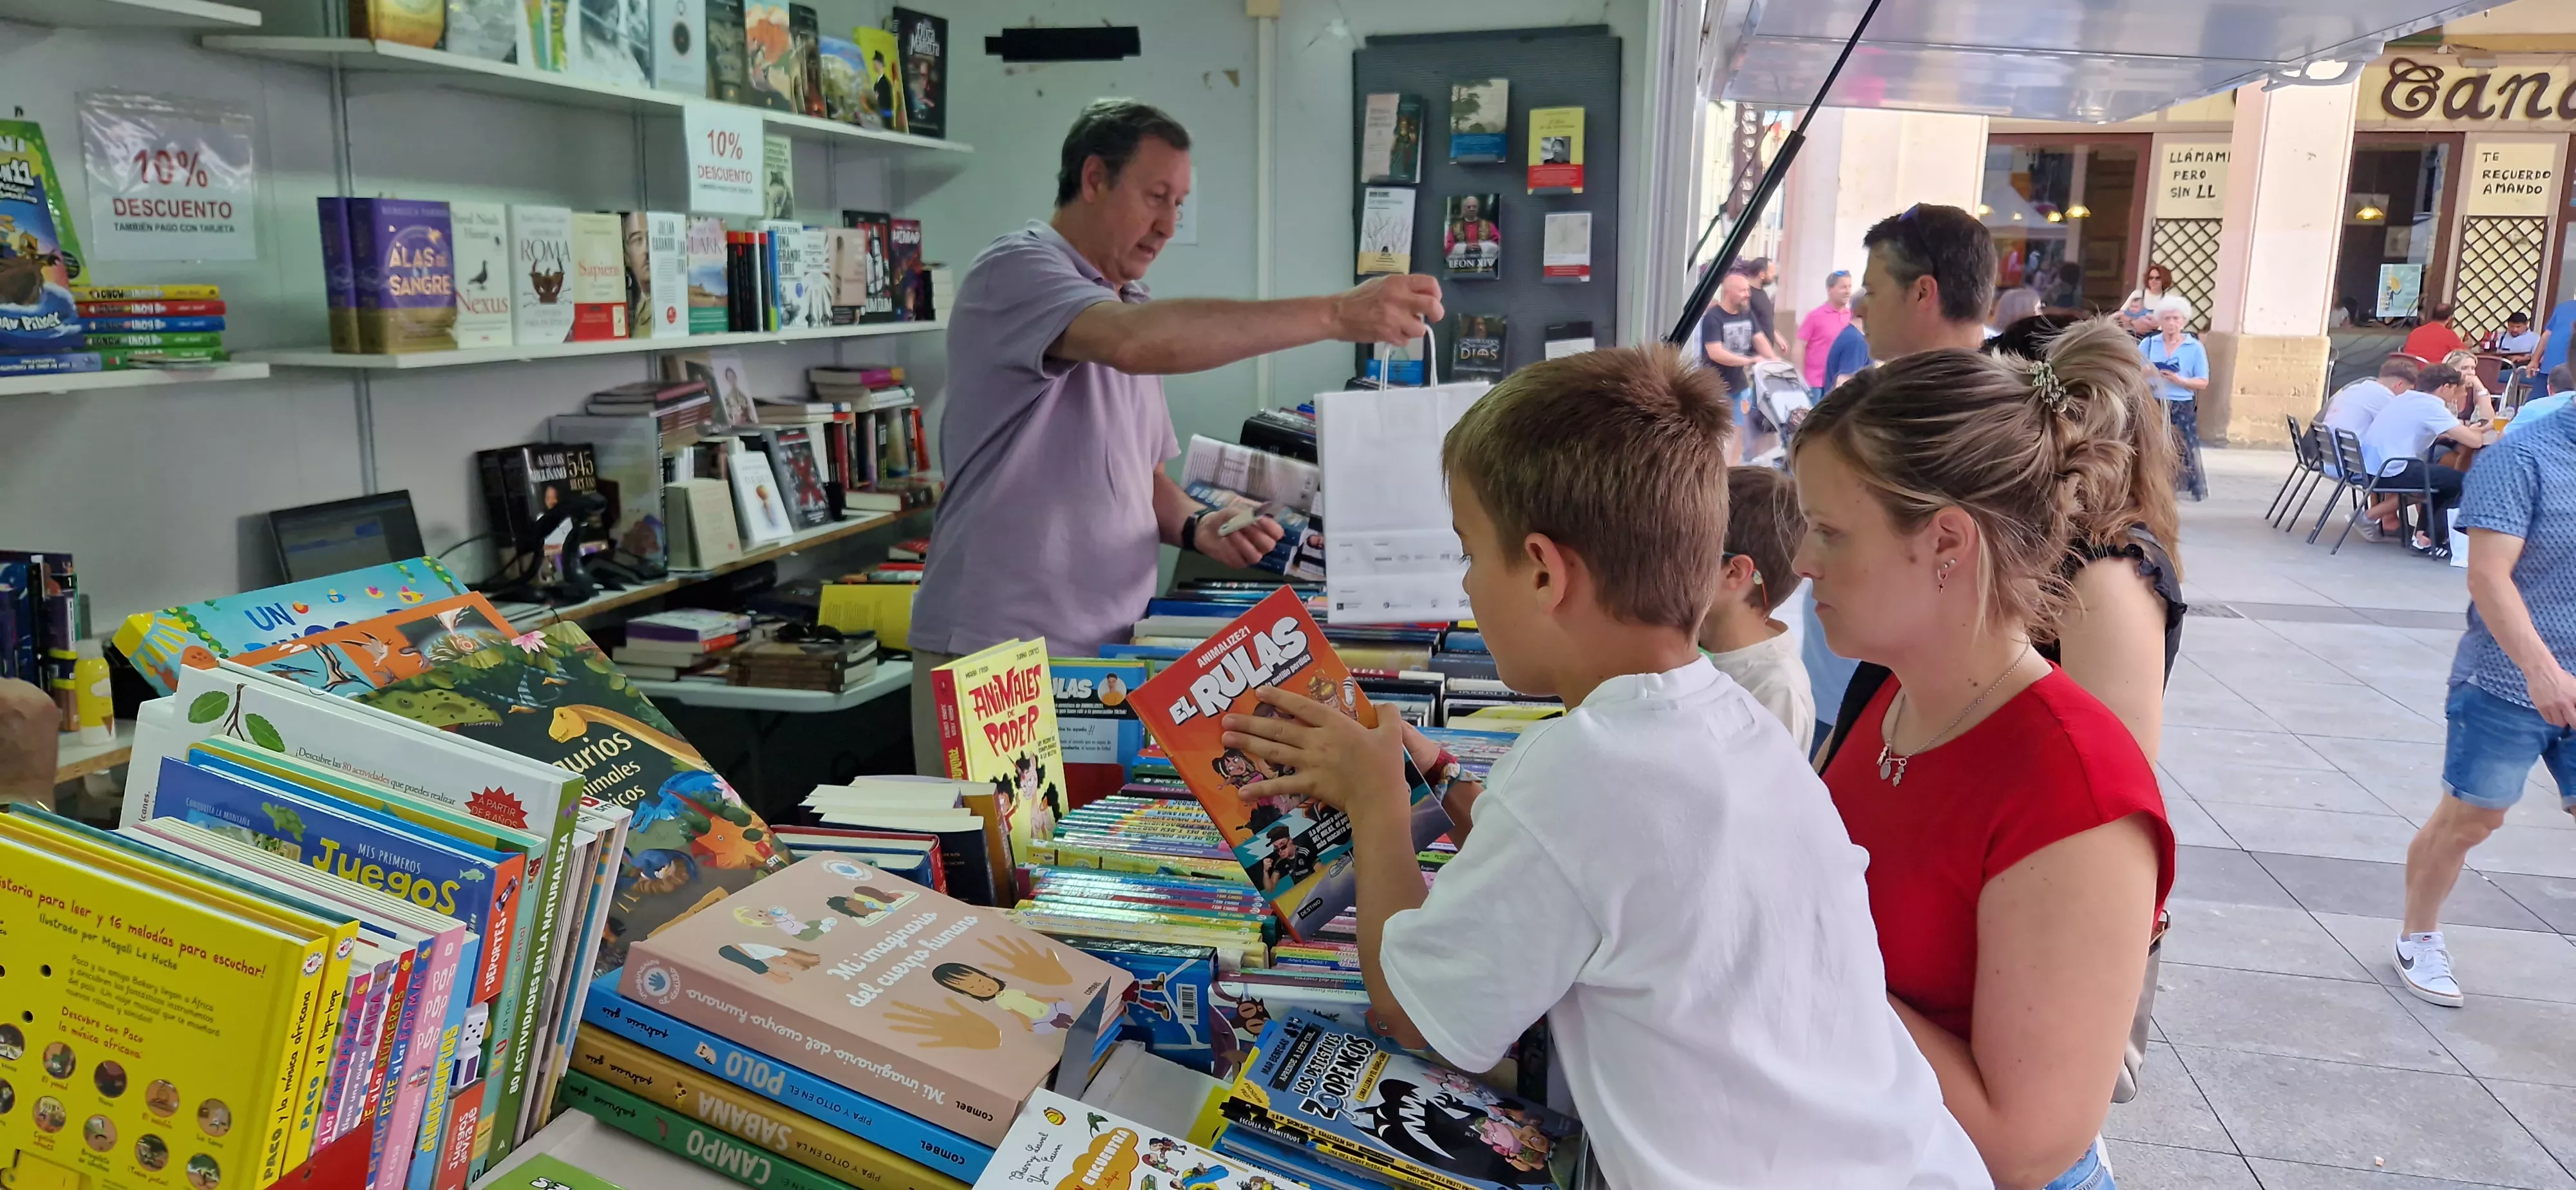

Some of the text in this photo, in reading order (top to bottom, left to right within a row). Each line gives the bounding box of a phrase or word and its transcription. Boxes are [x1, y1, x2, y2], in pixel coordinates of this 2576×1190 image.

[707, 129, 743, 160] 10%
[2483, 152, 2499, 162] TE
[134, 149, 208, 188] 10%
[697, 165, 752, 184] DESCUENTO
[2173, 169, 2206, 180] PERO
[2482, 170, 2552, 181] RECUERDO
[113, 198, 232, 219] DESCUENTO
[2170, 184, 2216, 199] SIN LL
[155, 223, 177, 232] PAGO
[180, 223, 198, 232] CON
[200, 223, 234, 233] TARJETA
[389, 247, 434, 268] ALAS
[520, 239, 571, 262] ROMA
[1477, 258, 1496, 268] XIV
[389, 274, 452, 297] SANGRE
[456, 290, 509, 314] Nexus
[566, 451, 594, 477] 545
[244, 601, 297, 632] UN
[1197, 625, 1252, 668] ANIMALIZE21
[1289, 653, 1312, 674] perdida
[1170, 616, 1308, 725] EL RULAS
[983, 704, 1041, 757] PODER
[1007, 708, 1016, 719] DE
[331, 757, 342, 770] las
[342, 760, 352, 771] 80
[351, 762, 390, 788] actividades
[390, 779, 405, 791] que
[404, 780, 430, 797] puedes
[430, 787, 456, 806] realizar
[471, 805, 483, 817] DE
[487, 798, 516, 818] PARTIR
[358, 843, 421, 874] MIS PRIMEROS
[765, 853, 781, 867] sm
[312, 838, 462, 915] Juegos
[1300, 899, 1321, 918] DESTINO
[38, 894, 65, 909] para
[71, 900, 91, 918] leer
[96, 914, 104, 929] y
[109, 915, 122, 929] 16
[128, 927, 174, 948] melodías
[179, 942, 207, 959] para
[213, 953, 267, 979] escuchar!
[82, 931, 97, 943] por
[486, 920, 507, 985] DEPORTES
[515, 925, 526, 963] pañal
[827, 911, 938, 981] Mi imaginario
[432, 963, 457, 994] POP
[509, 832, 570, 1095] 80 ACTIVIDADES EN LA NATURALEZA
[847, 915, 979, 1008] del cuerpo humano
[398, 969, 426, 1041] FORMAS
[424, 995, 448, 1026] POP
[502, 999, 512, 1015] no
[377, 989, 406, 1069] NÚMEROS
[417, 1025, 440, 1057] POP
[502, 1018, 511, 1035] ya
[299, 988, 342, 1131] PACO el hip-hop
[341, 990, 384, 1131] tiene una nueva AMIGA
[396, 1042, 406, 1062] las
[489, 1038, 508, 1081] IKU
[625, 1017, 787, 1096] POLO patricia
[686, 988, 946, 1106] Mi imaginario del cuerpo humano
[1260, 1037, 1291, 1076] MAR BENEGAS
[263, 990, 312, 1182] PACO la música africana
[379, 1075, 399, 1116] PEPE
[419, 1024, 460, 1153] dinosaurios
[1293, 1077, 1316, 1096] LOS
[609, 1063, 793, 1152] SABANA patricia
[789, 1084, 873, 1127] PIPA Y OTTO EN EL
[449, 1115, 469, 1171] Juegos
[460, 1106, 478, 1146] viaje
[686, 1129, 772, 1185] CAMPO
[796, 1140, 882, 1183] PIPA Y OTTO EN LA
[1081, 1129, 1130, 1186] ENCUENTRA
